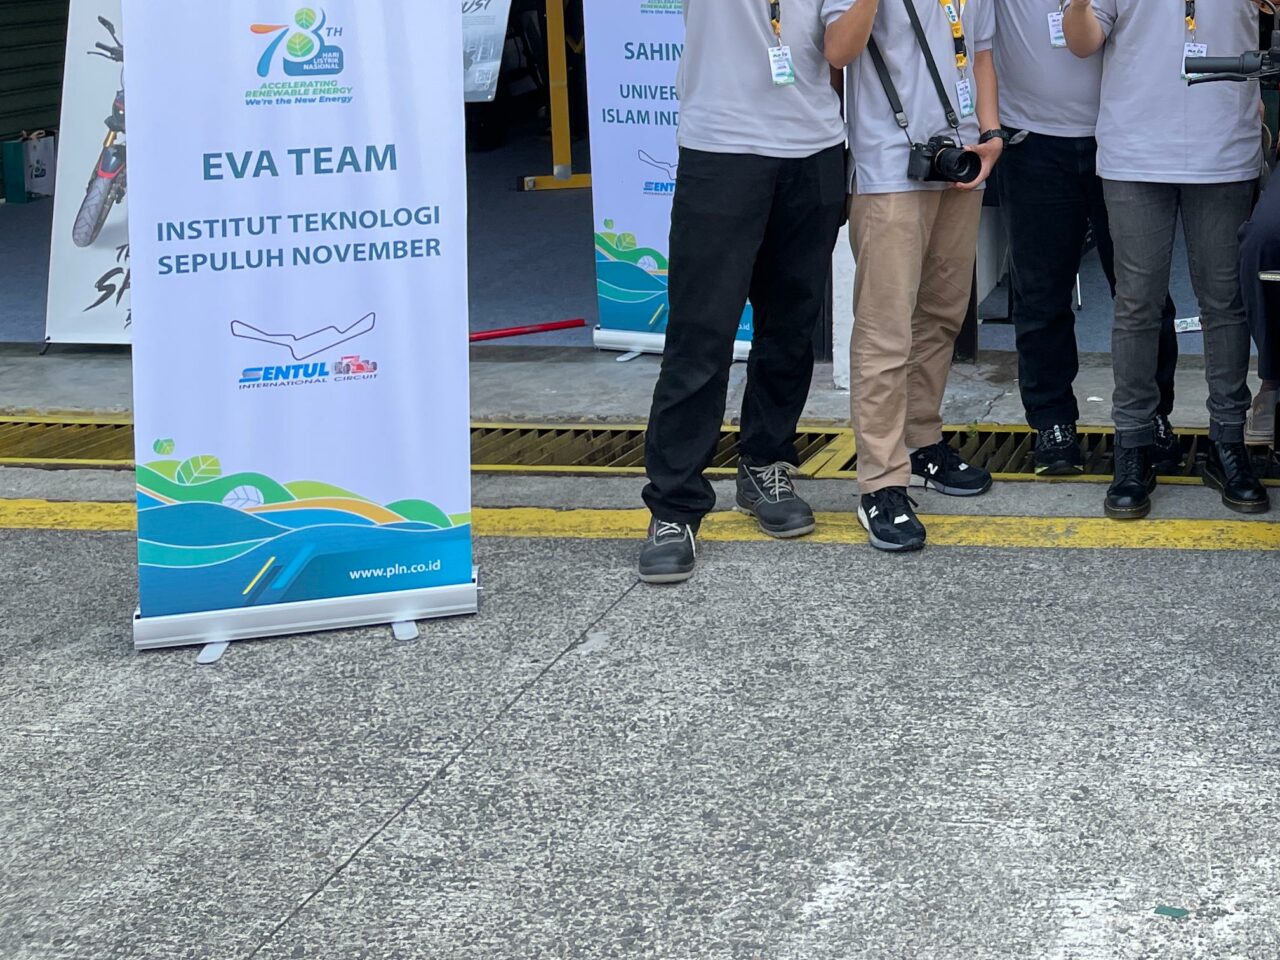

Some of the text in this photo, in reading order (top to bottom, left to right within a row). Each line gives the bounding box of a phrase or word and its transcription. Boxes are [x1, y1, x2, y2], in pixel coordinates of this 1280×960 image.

[624, 42, 684, 61] SAHIN
[245, 87, 353, 98] RENEWABLE ENERGY
[260, 80, 338, 90] ACCELERATING
[619, 84, 680, 101] UNIVER
[245, 98, 273, 106] We're
[319, 95, 353, 104] Energy
[602, 108, 650, 125] ISLAM
[202, 143, 398, 181] EVA TEAM
[643, 181, 675, 192] SENT
[157, 206, 440, 242] INSTITUT TEKNOLOGI
[158, 248, 284, 276] SEPULUH
[292, 238, 442, 266] NOVEMBER
[238, 362, 330, 383] SENTUL
[238, 374, 378, 390] INTERNATIONAL CIRCUIT
[349, 559, 441, 580] www.pln.co.id
